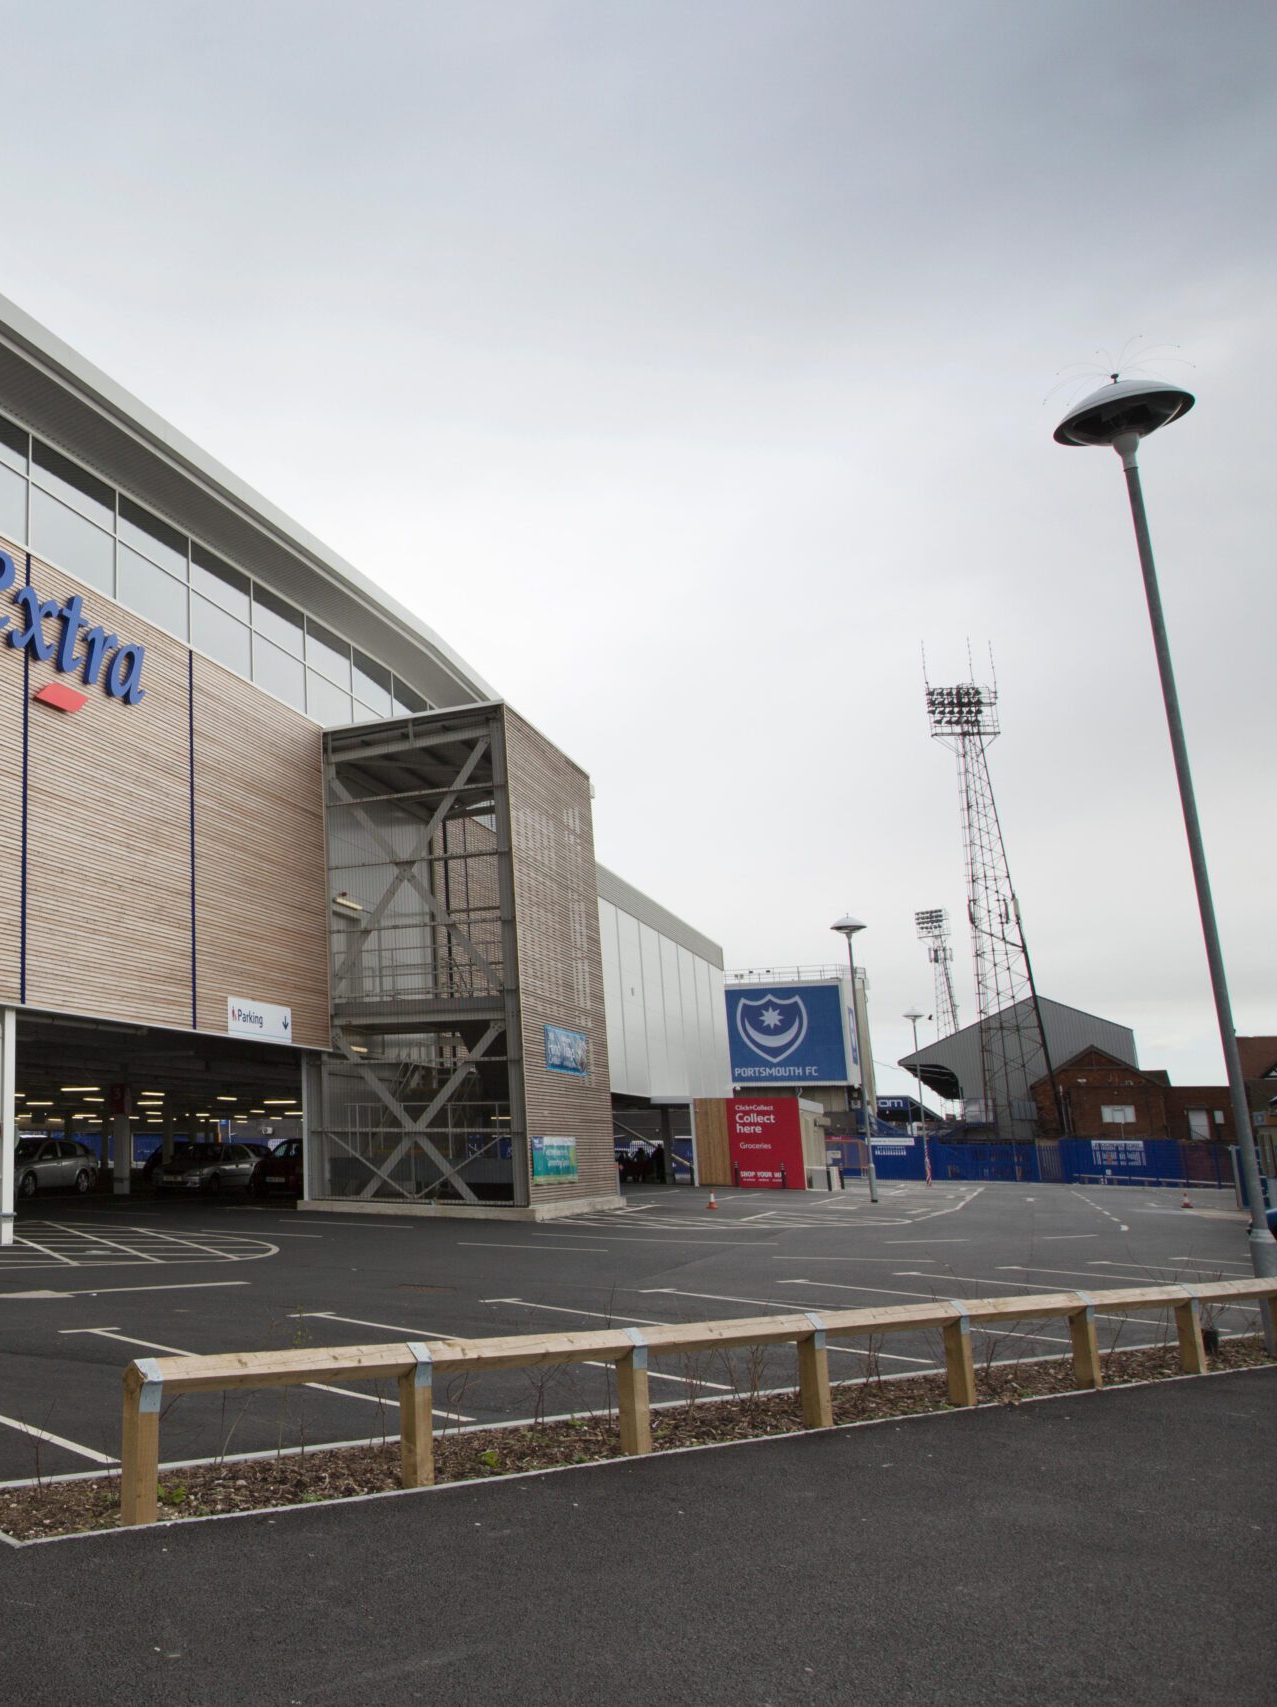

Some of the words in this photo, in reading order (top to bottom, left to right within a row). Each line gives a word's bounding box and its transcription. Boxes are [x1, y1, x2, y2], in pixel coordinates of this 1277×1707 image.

[237, 1008, 263, 1029] Parking
[734, 1066, 803, 1077] PORTSMOUTH
[805, 1066, 819, 1076] FC
[735, 1112, 776, 1123] Collect
[736, 1123, 762, 1134] here
[739, 1142, 772, 1150] Groceries
[740, 1170, 755, 1178] SHOP
